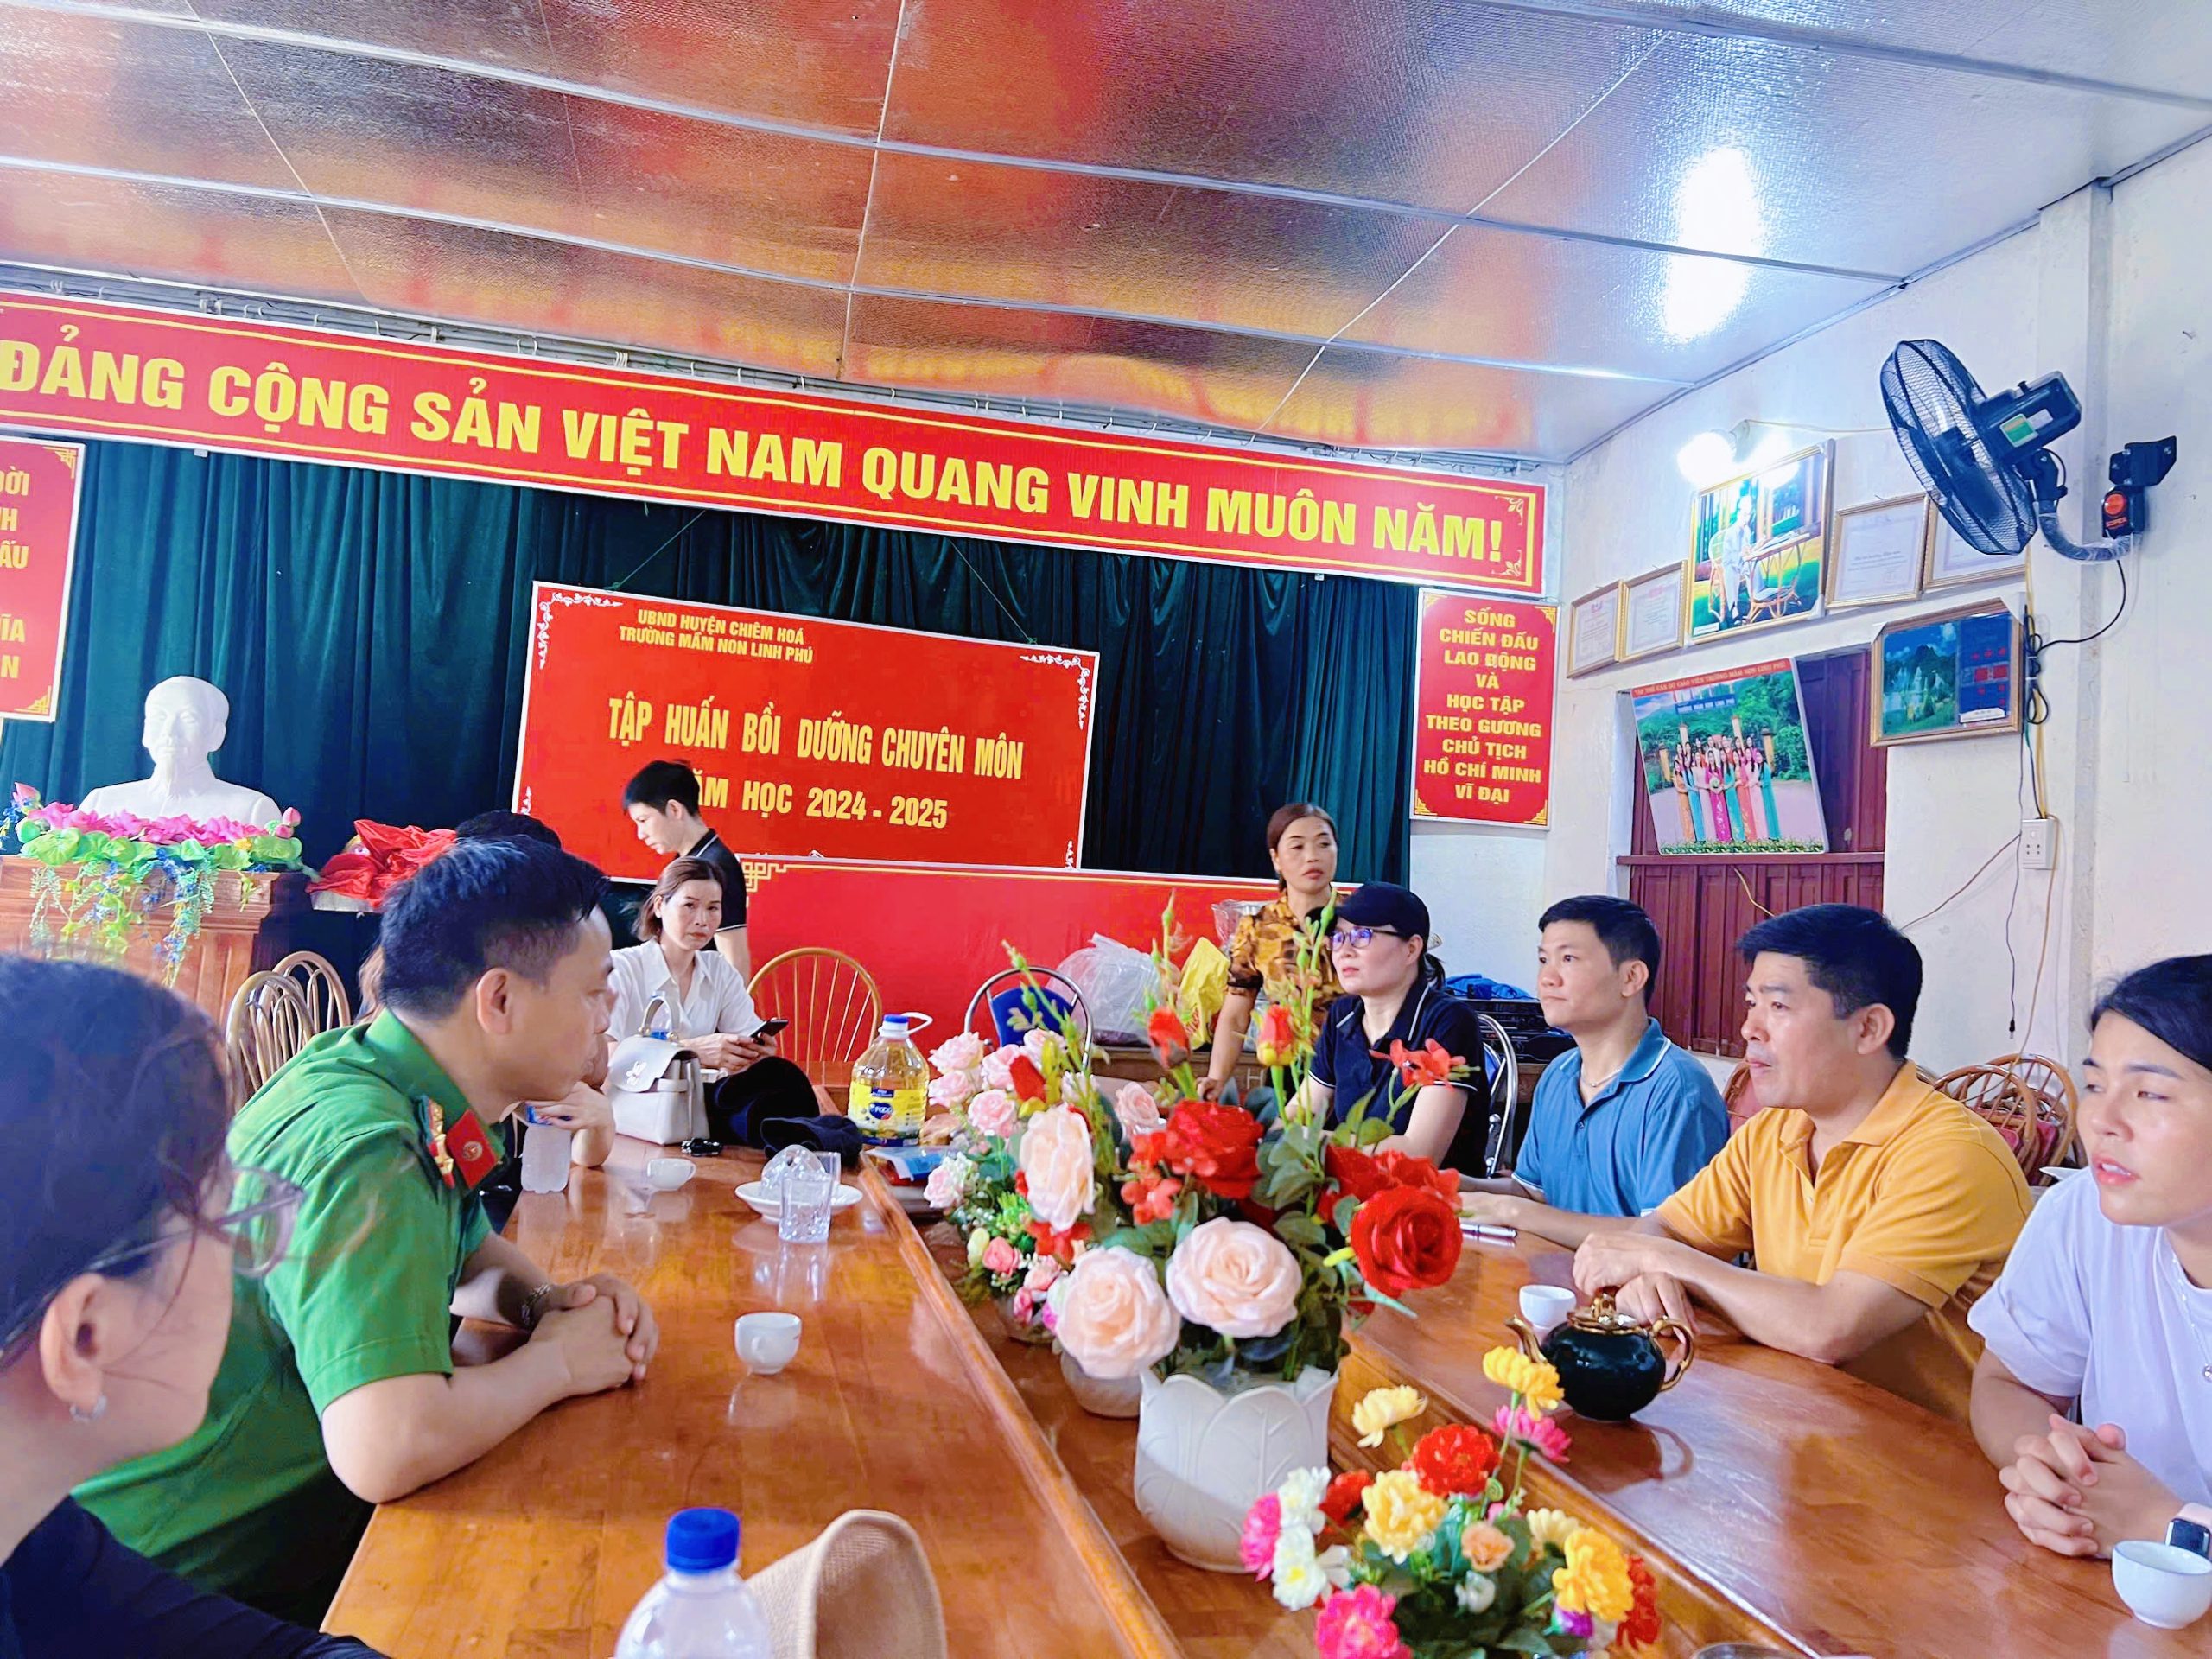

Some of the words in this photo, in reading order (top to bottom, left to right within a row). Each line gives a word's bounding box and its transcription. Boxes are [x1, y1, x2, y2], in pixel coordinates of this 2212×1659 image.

[0, 323, 185, 410] ĐẢNG
[207, 361, 389, 435] CỘNG
[410, 376, 542, 454] SẢN
[562, 407, 689, 475] VIỆT
[706, 427, 842, 489] NAM
[861, 447, 1050, 514] QUANG
[1067, 472, 1189, 529] VINH
[1206, 487, 1357, 545] MUÔN
[1372, 503, 1503, 563] NĂM!
[638, 608, 677, 628] UBND
[680, 615, 727, 635] HUYỆN
[728, 620, 773, 641] CHIÊM
[776, 627, 805, 645] HOÁ
[1464, 607, 1516, 628] SỐNG
[619, 625, 676, 647] TRƯỜNG
[677, 631, 715, 652] MẦM
[717, 638, 747, 656] NON
[750, 642, 782, 660] LINH
[785, 645, 814, 664] PHÚ
[1439, 627, 1496, 647] CHIẾN
[1501, 631, 1538, 651] ĐẤU
[1444, 650, 1479, 665] LAO
[1484, 652, 1536, 672] ĐỘNG
[1475, 671, 1499, 690] VÀ
[1446, 693, 1484, 713] HỌC
[1490, 696, 1524, 715] TẬP
[608, 690, 653, 747] TẬP
[664, 695, 730, 750] HUẤN
[741, 701, 782, 755] BỒI
[797, 710, 873, 765] DƯỠNG
[881, 725, 966, 774] CHUYÊN
[974, 732, 1024, 779] MÔN
[1426, 715, 1472, 732] THEO
[1478, 719, 1541, 737] GƯƠNG
[1442, 736, 1479, 755] CHỦ
[1485, 742, 1527, 760] TỊCH
[1424, 757, 1449, 775] HỒ
[1455, 761, 1486, 778] CHÍ
[1492, 766, 1541, 783] MINH
[741, 779, 793, 818] HỌC
[806, 786, 867, 821] 2024
[889, 795, 948, 829] 2025
[1455, 782, 1472, 800] VĨ
[1478, 786, 1510, 804] ĐẠI
